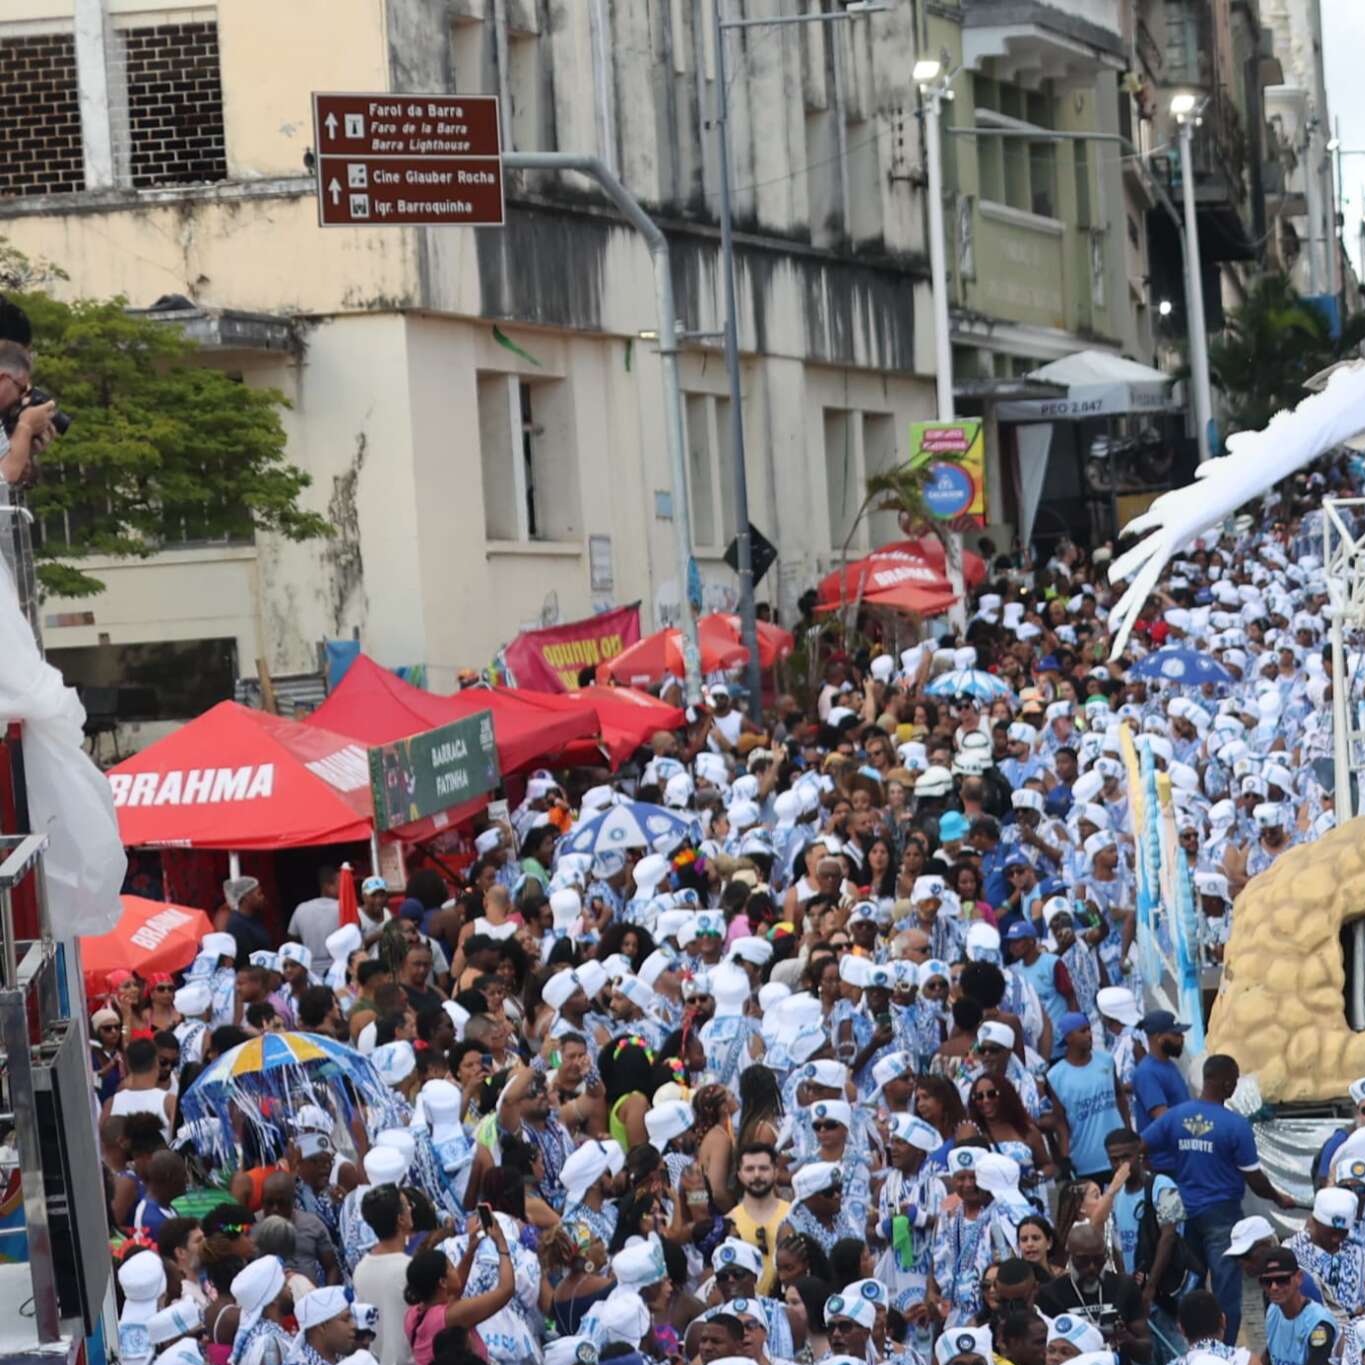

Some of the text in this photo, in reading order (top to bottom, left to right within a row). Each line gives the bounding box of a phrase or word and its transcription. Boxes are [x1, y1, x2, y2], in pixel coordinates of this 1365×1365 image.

[369, 103, 463, 118] Farol da Barra
[371, 122, 467, 134] Faro de la Barra
[372, 139, 471, 154] Barra Lighthouse
[373, 170, 495, 184] Cine Glauber Rocha
[375, 200, 472, 217] Igr. Barroquinha
[107, 763, 275, 808] BRAHMA
